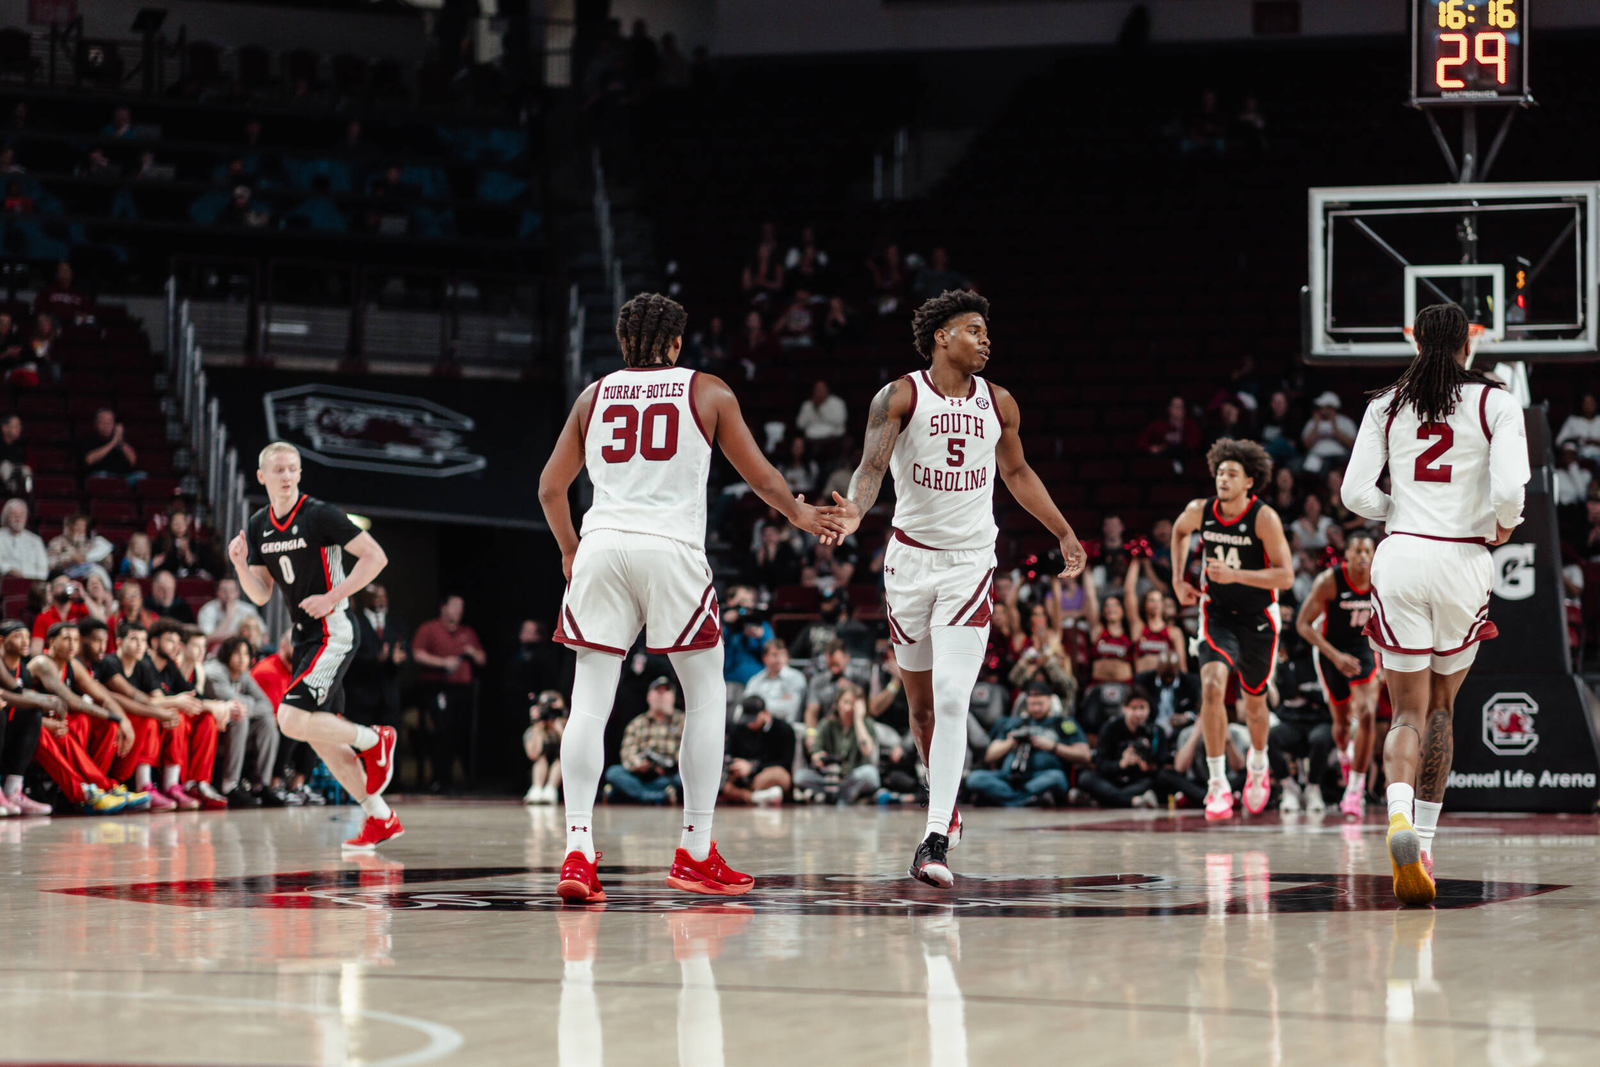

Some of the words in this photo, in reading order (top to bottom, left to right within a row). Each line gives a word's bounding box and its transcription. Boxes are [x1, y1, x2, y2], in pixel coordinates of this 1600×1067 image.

[1438, 0, 1516, 30] 16:16
[1436, 31, 1507, 88] 29
[602, 383, 685, 400] MURRAY-BOYLES
[601, 402, 680, 464] 30
[929, 413, 985, 440] SOUTH
[946, 437, 966, 467] 5
[1413, 421, 1454, 483] 2
[912, 462, 987, 492] CAROLINA
[261, 537, 308, 554] GEORGIA
[1203, 530, 1252, 546] GEORGIA
[278, 554, 296, 585] 0
[1214, 545, 1241, 569] 14
[1446, 769, 1501, 788] lonial
[1503, 769, 1536, 788] Life
[1539, 769, 1597, 788] Arena
